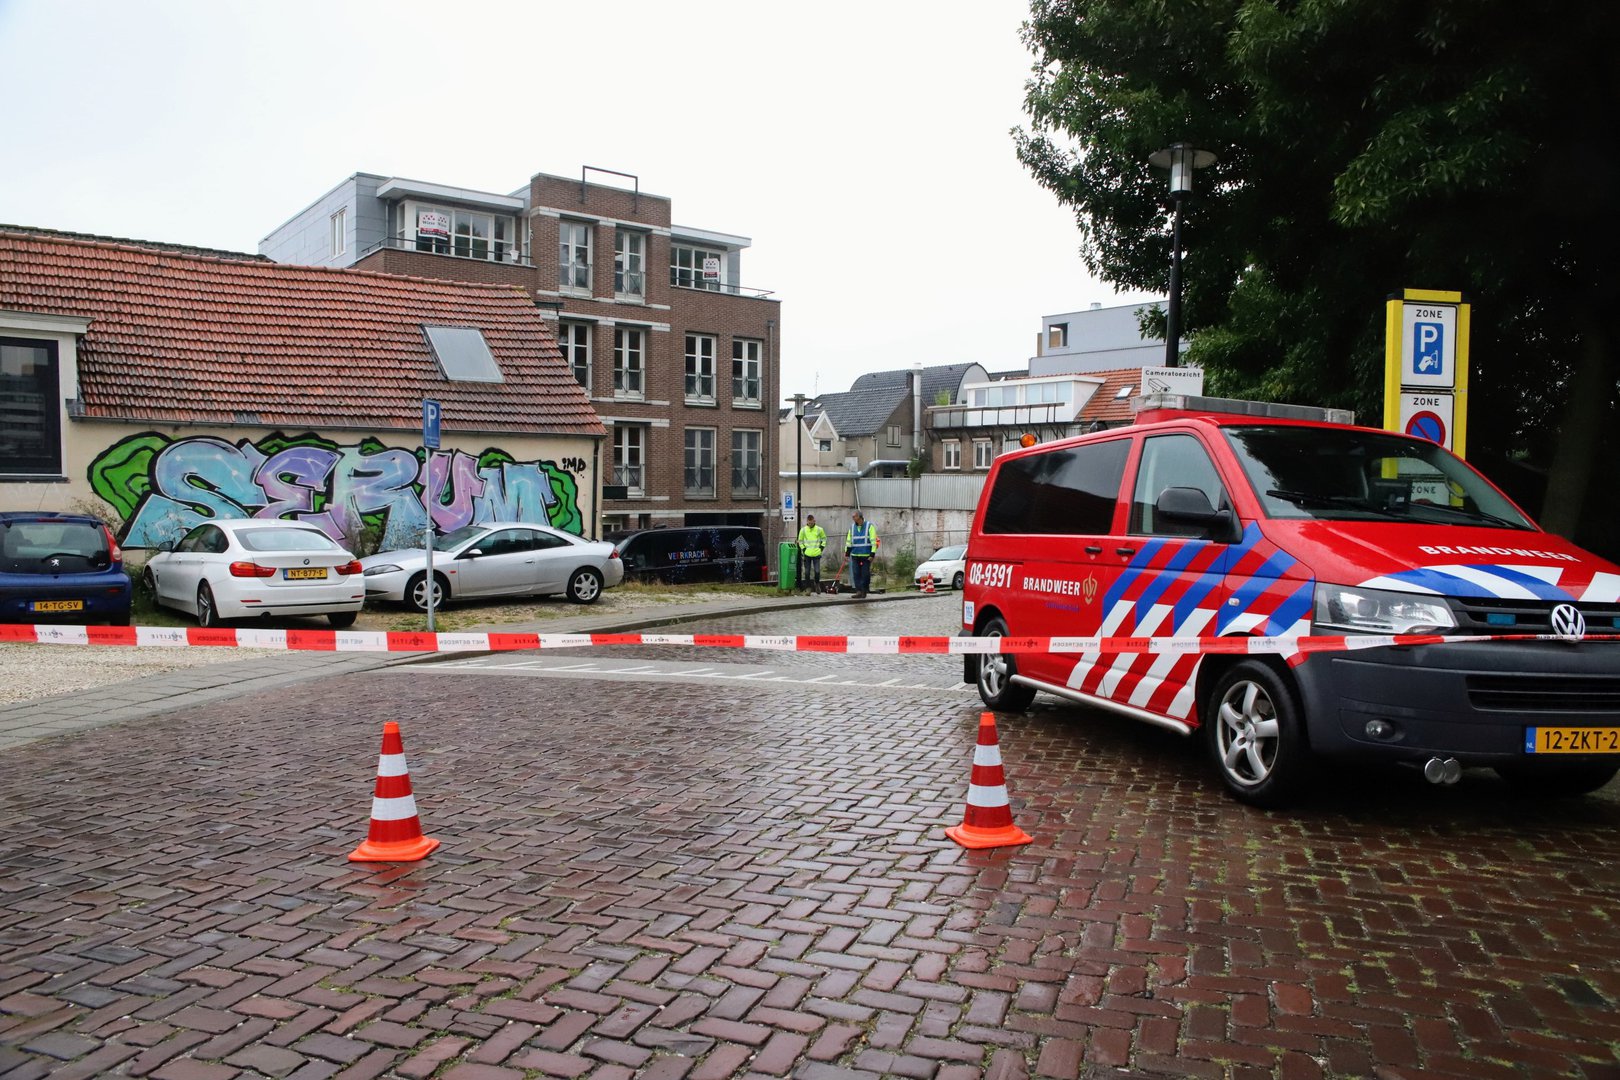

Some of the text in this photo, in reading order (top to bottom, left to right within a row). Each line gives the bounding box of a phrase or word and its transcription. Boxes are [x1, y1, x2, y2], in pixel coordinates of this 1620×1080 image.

[1416, 309, 1443, 318] ZONE
[1420, 325, 1438, 353] P
[1145, 369, 1201, 378] Cameratoezicht
[1413, 397, 1440, 406] ZONE
[427, 404, 437, 428] P
[1418, 545, 1582, 562] BRANDWEER
[290, 569, 323, 577] NT-877-F
[969, 562, 1014, 588] 08-9391
[1023, 577, 1080, 596] BRANDWEER
[39, 601, 79, 610] 14-TG-SV
[1545, 730, 1618, 750] 12-ZKT-2
